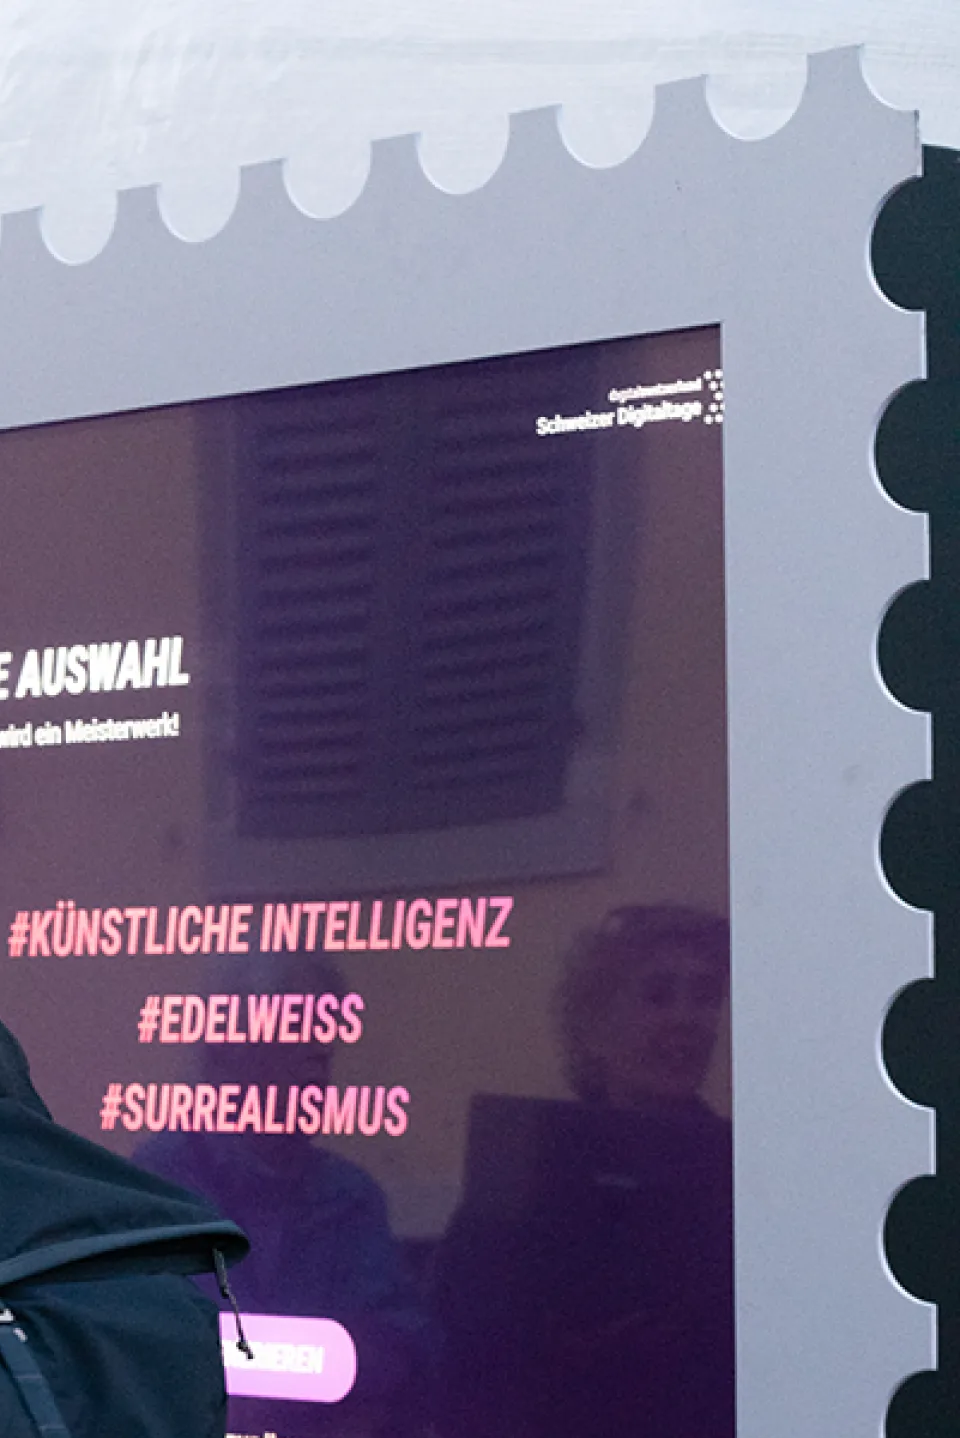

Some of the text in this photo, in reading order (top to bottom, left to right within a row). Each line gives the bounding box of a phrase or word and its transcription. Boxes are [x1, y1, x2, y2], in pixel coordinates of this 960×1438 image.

[536, 401, 702, 435] Schweizer Digitaltage
[15, 635, 190, 699] AUSWAHL
[34, 721, 62, 746] ein
[64, 711, 180, 744] Meisterwerk!
[8, 896, 515, 957] #KÜNSTLICHE INTELLIGENZ
[138, 992, 365, 1044] #EDELWEISS
[100, 1082, 411, 1137] #SURREALISMUS
